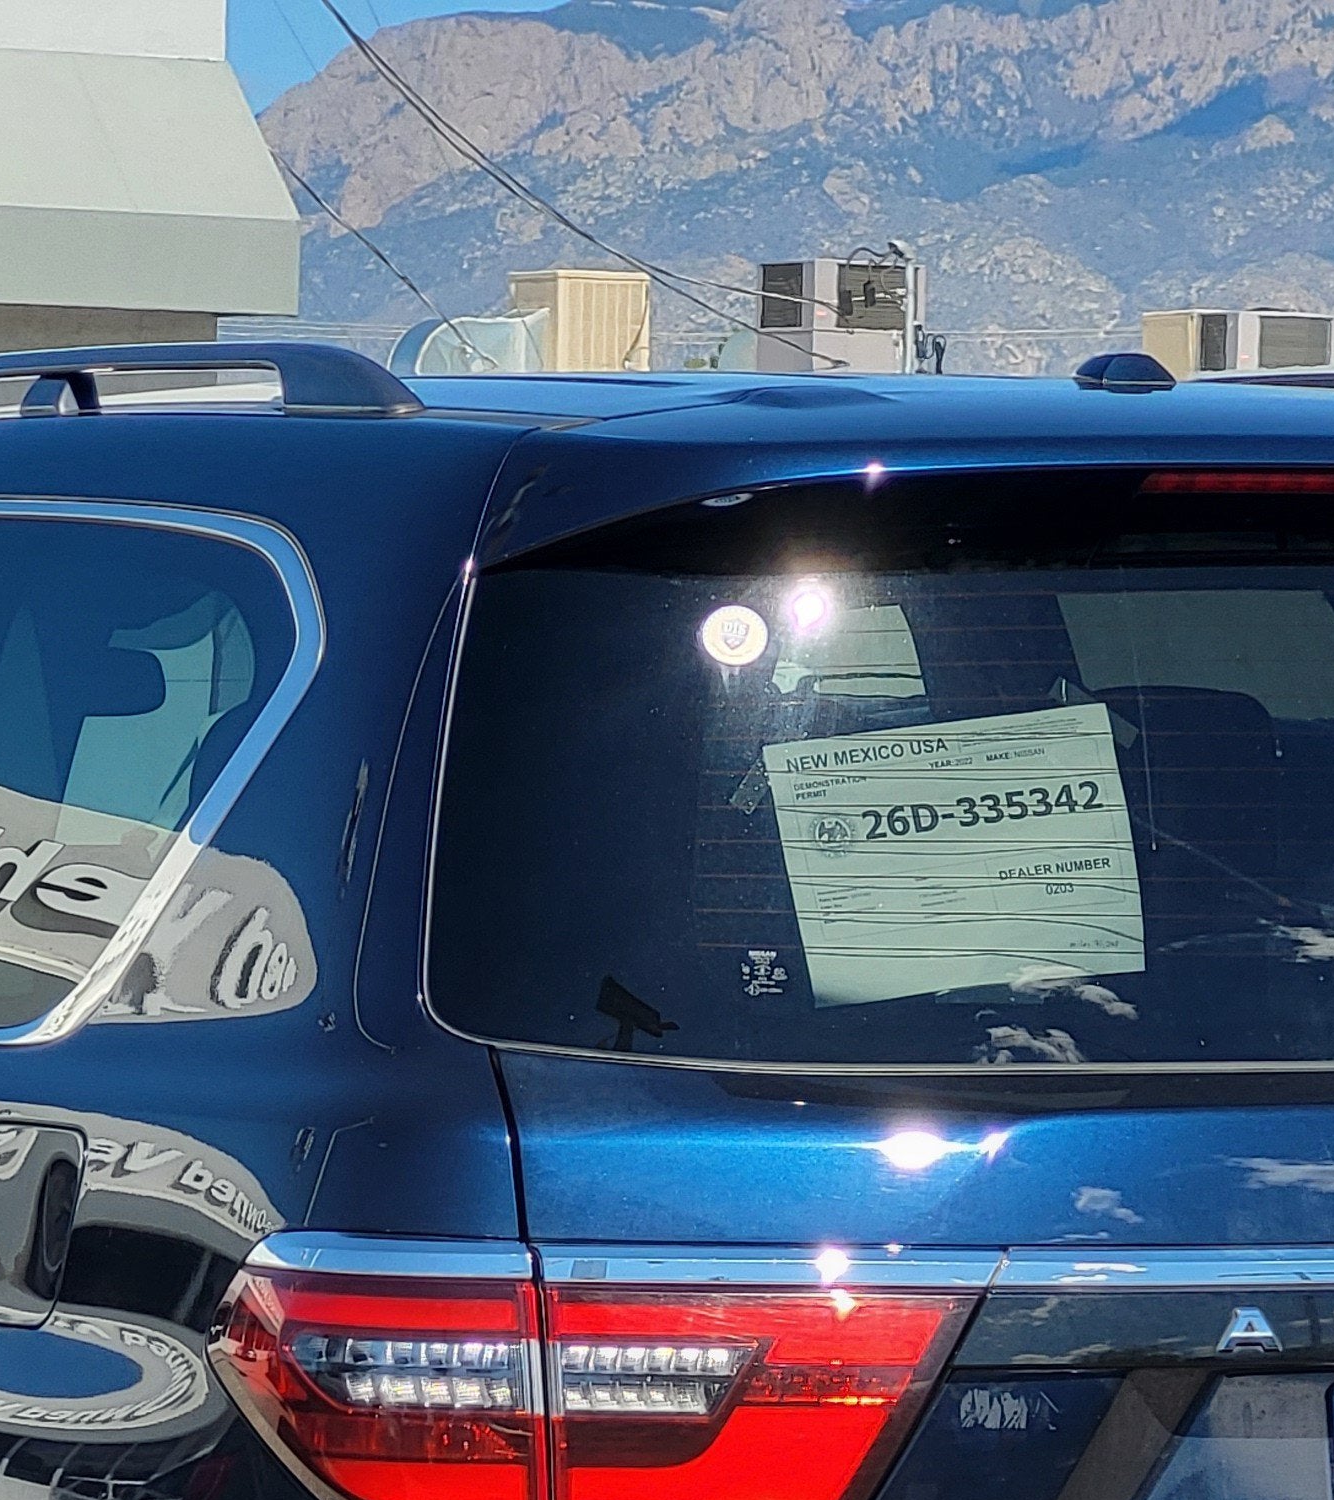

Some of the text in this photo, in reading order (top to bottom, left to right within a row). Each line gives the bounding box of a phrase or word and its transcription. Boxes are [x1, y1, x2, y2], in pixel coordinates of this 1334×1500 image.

[786, 738, 949, 773] NEW MEXICO USA
[862, 781, 1104, 840] 26D-335342
[999, 857, 1111, 880] DEALER NUMBER
